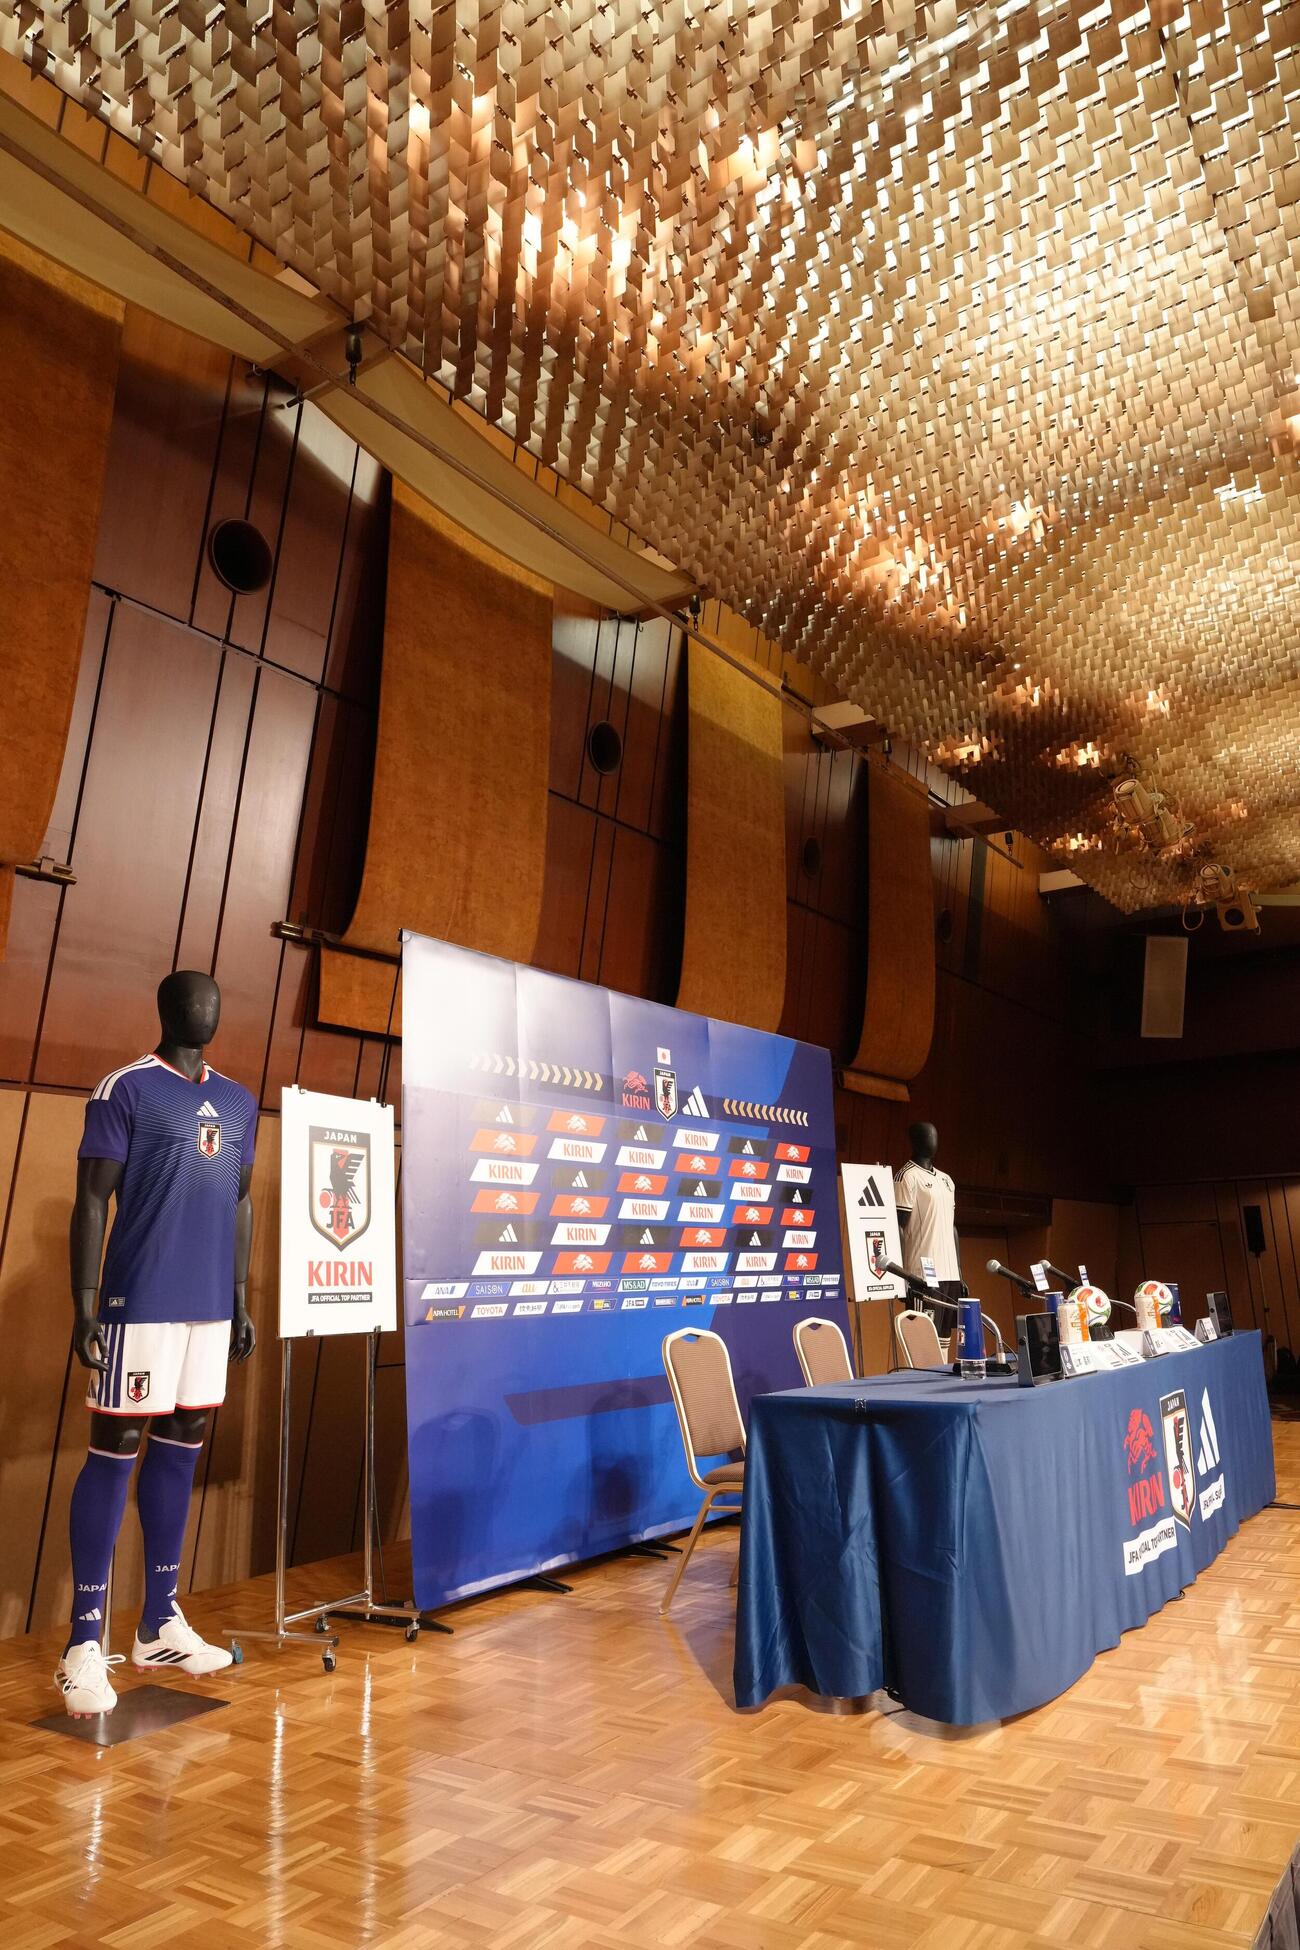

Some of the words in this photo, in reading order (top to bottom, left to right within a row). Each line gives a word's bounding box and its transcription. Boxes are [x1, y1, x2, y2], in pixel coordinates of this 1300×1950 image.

[622, 1093, 650, 1110] KIRIN
[324, 1131, 357, 1143] JAPAN
[684, 1133, 709, 1147] KIRIN
[562, 1143, 593, 1158] KIRIN
[628, 1151, 655, 1165] KIRIN
[488, 1164, 523, 1180] KIRIN
[785, 1168, 804, 1180] KIRIN
[740, 1186, 762, 1198] KIRIN
[631, 1203, 658, 1216] KIRIN
[689, 1206, 714, 1219] KIRIN
[326, 1211, 355, 1229] JFA
[566, 1227, 597, 1241] KIRIN
[791, 1234, 809, 1245] KIRIN
[491, 1256, 526, 1270] KIRIN
[692, 1256, 717, 1268] KIRIN
[745, 1256, 767, 1268] KIRIN
[308, 1261, 373, 1286] KIRIN
[475, 1283, 503, 1295] SAISON
[623, 1280, 646, 1291] MS&AD
[476, 1306, 503, 1315] TOYOTA
[1129, 1549, 1140, 1564] JFA
[155, 1563, 180, 1572] JAP
